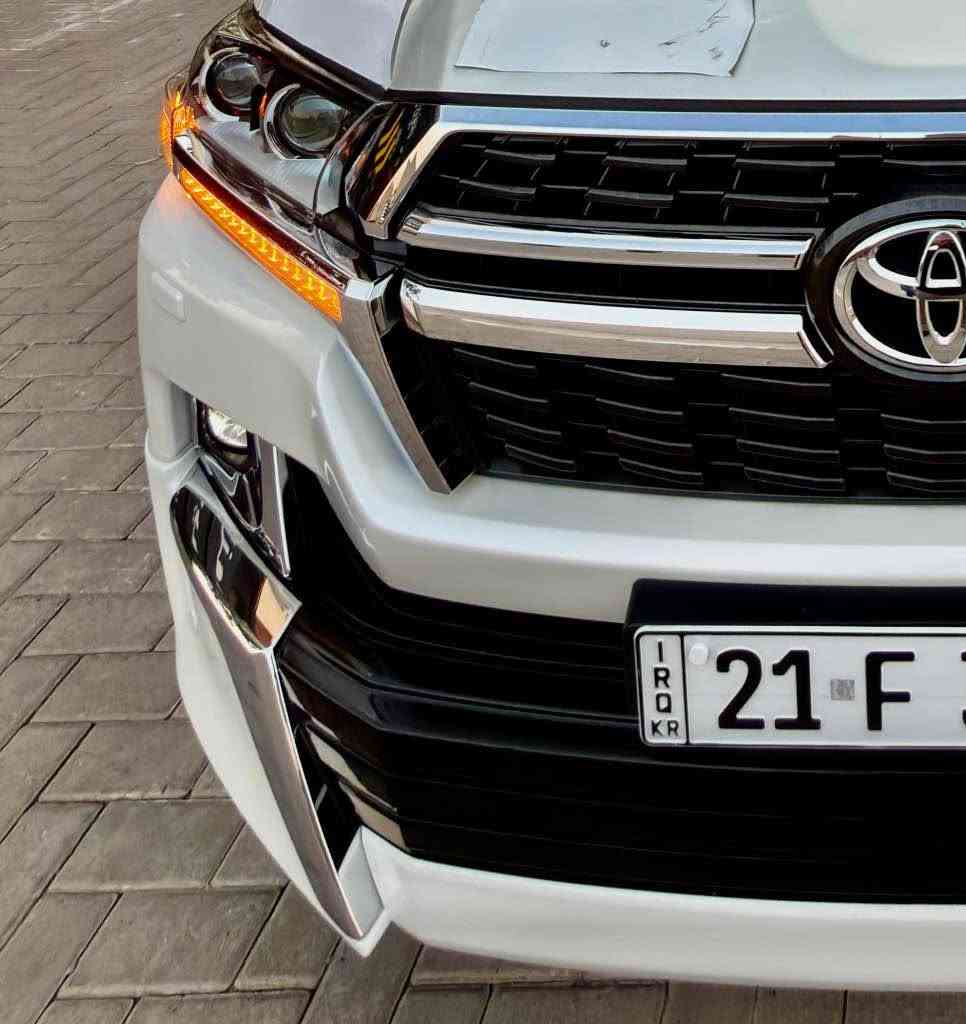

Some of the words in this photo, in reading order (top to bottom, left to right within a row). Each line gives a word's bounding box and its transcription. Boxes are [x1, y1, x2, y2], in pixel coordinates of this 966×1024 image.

[715, 649, 821, 730] 21
[864, 651, 916, 731] F
[651, 719, 680, 739] KR
